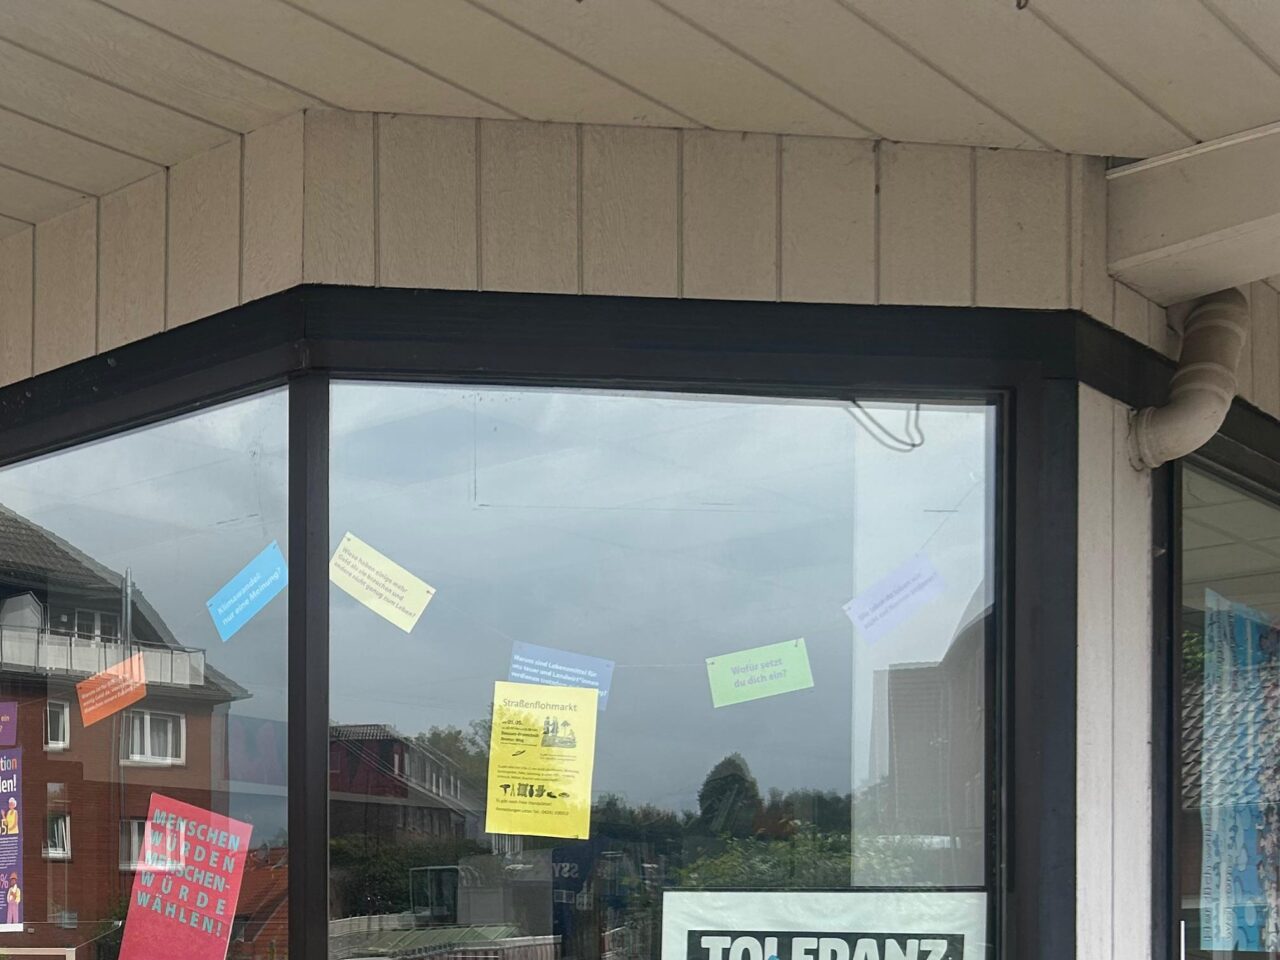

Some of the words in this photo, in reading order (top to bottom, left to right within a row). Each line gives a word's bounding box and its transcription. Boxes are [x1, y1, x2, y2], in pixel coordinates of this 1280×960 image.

[734, 678, 746, 689] du
[747, 673, 768, 686] dich
[768, 668, 787, 681] ein?
[759, 658, 784, 670] setzt
[502, 698, 578, 712] Straßenflohmarkt
[150, 829, 235, 874] WÜRDEN
[152, 808, 241, 853] MENSCHEN
[141, 870, 227, 916] WÜRDE
[144, 849, 231, 893] MENSCHEN-
[136, 889, 223, 938] WÄHLEN!
